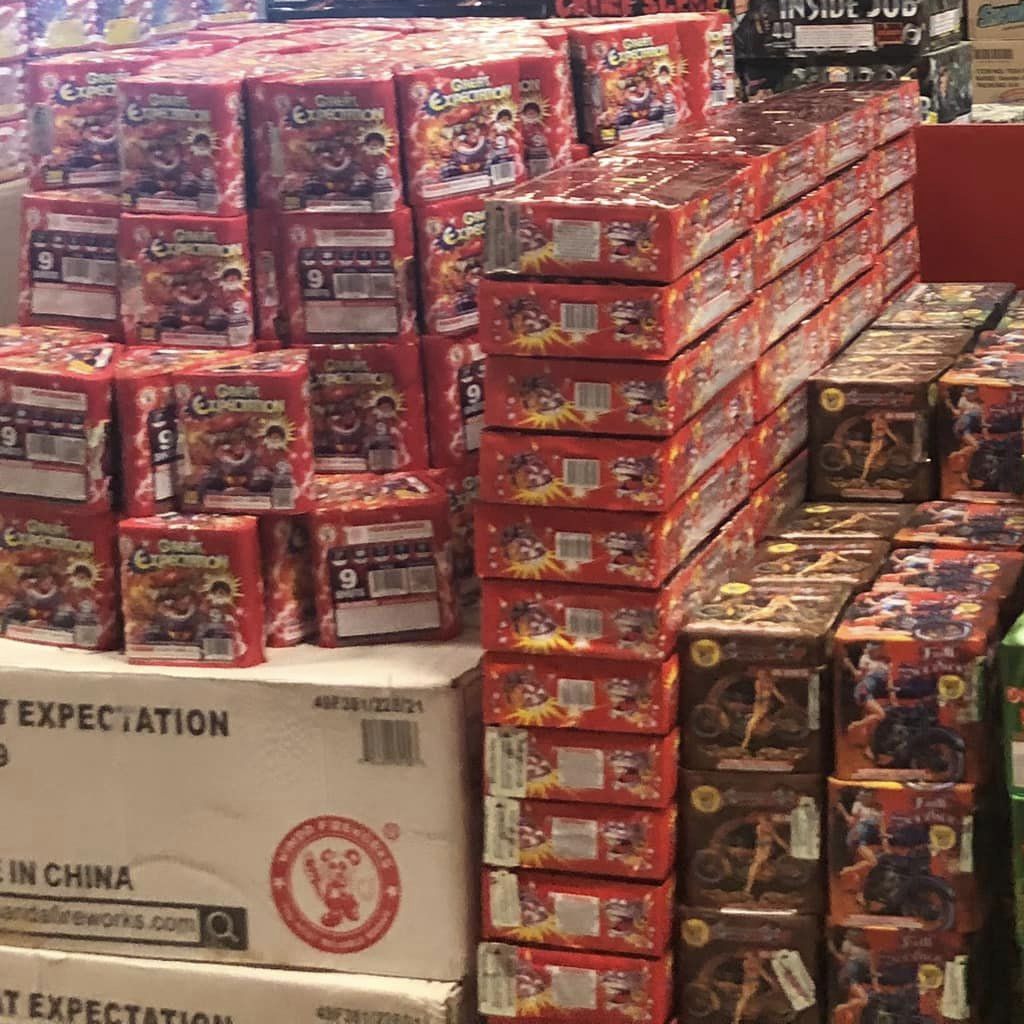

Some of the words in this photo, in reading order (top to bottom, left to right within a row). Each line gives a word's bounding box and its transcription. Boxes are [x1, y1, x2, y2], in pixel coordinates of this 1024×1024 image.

[37, 251, 54, 271] 9
[307, 269, 324, 288] 9
[339, 568, 357, 589] 9
[17, 699, 230, 737] EXPECTATION
[9, 859, 37, 886] IN
[44, 862, 135, 891] CHINA
[29, 993, 233, 1024] EXPECTATION
